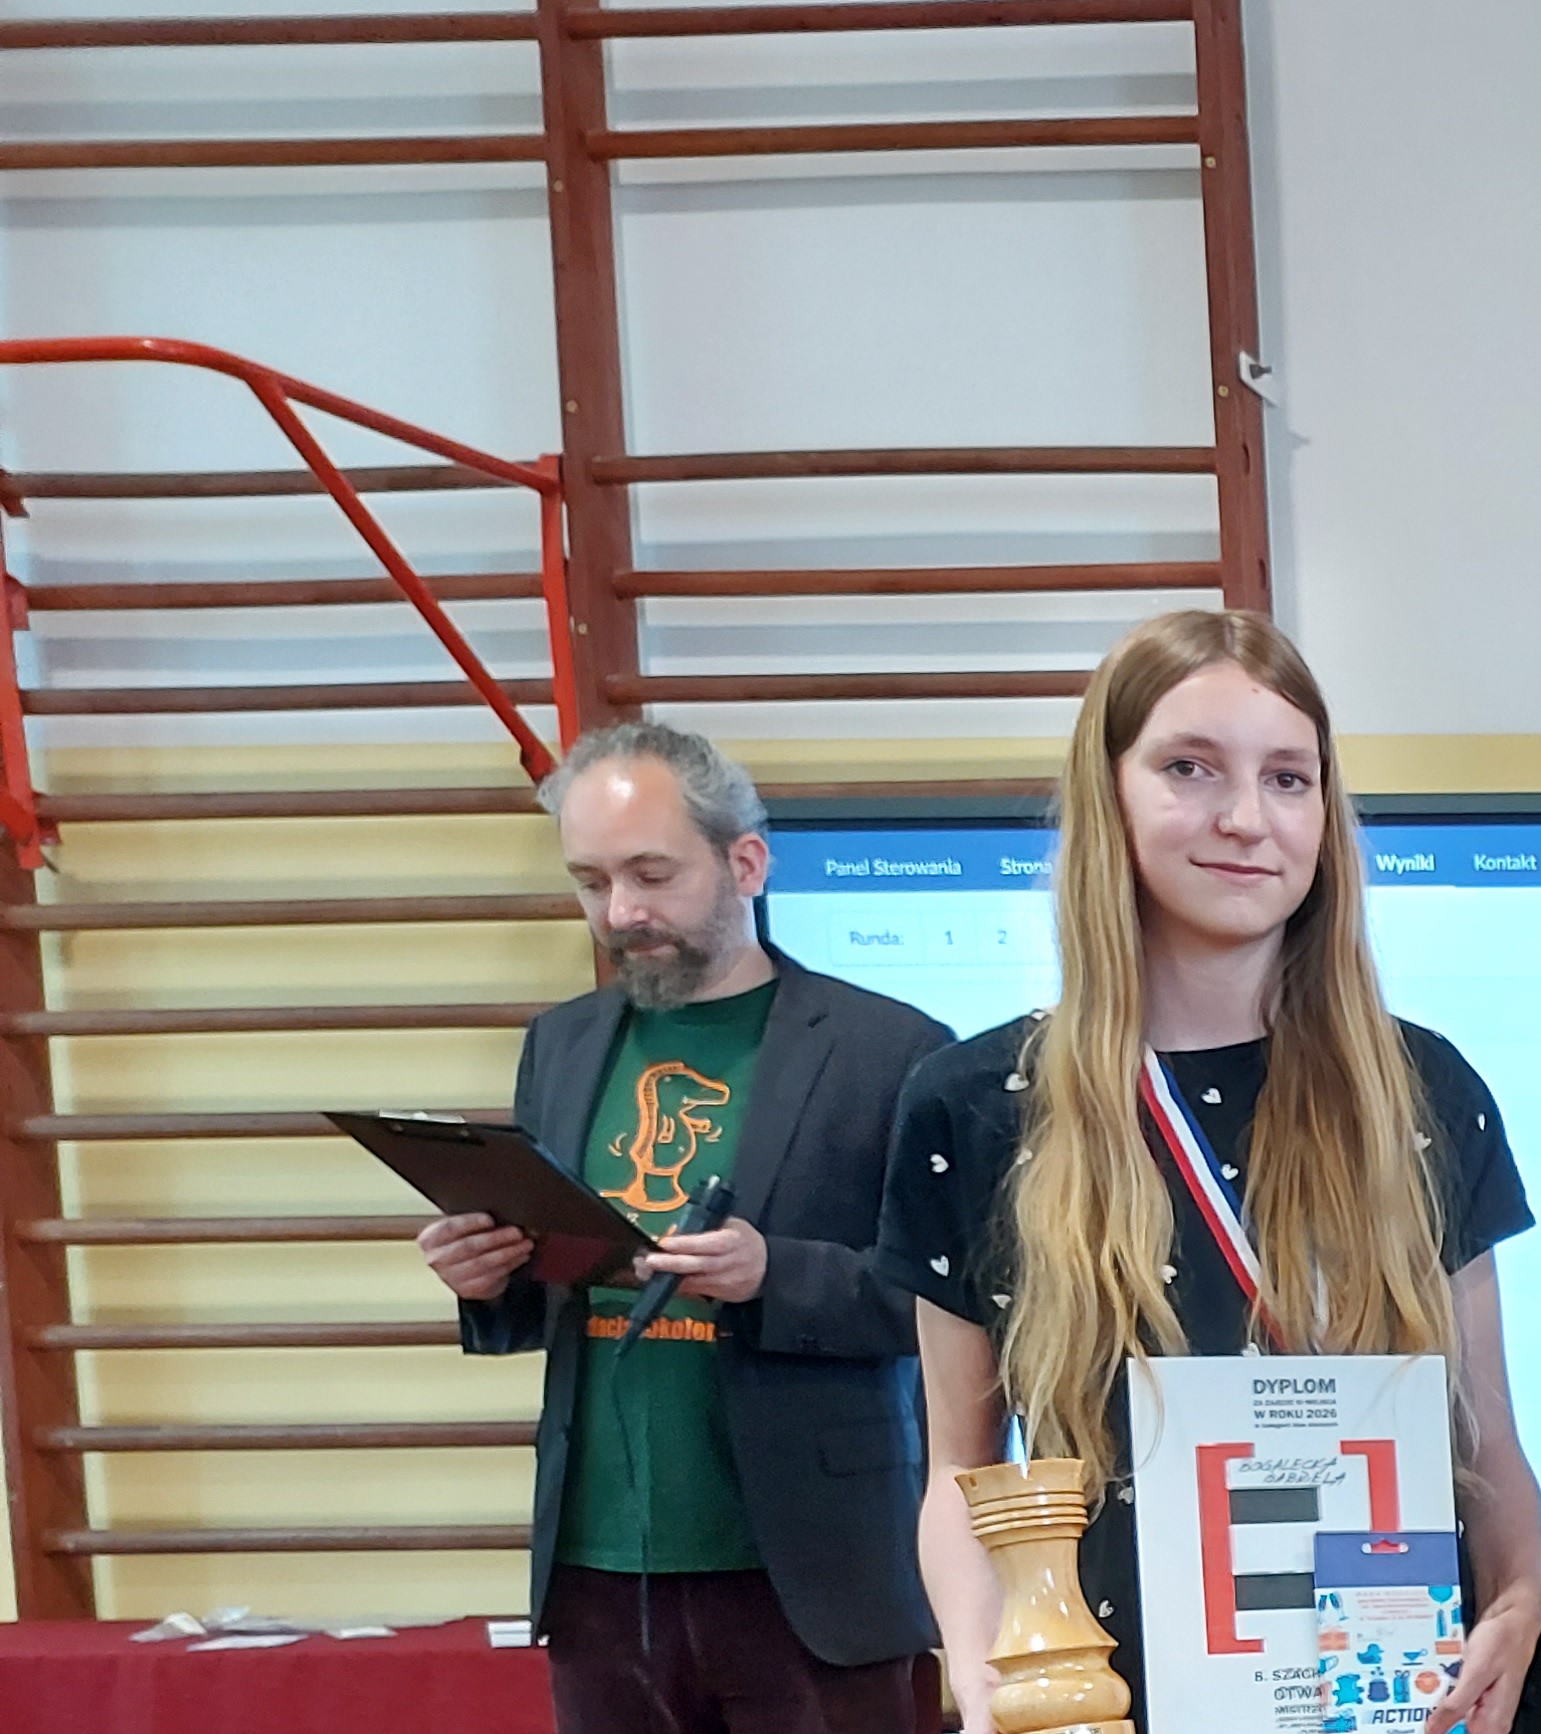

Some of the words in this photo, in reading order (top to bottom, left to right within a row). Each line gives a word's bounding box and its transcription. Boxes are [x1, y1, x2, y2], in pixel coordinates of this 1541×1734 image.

[824, 858, 870, 876] Panel
[873, 857, 962, 876] Sterowania
[1376, 853, 1435, 875] Wyniki
[1473, 853, 1538, 872] Kontakt
[944, 930, 953, 945] 1
[997, 930, 1007, 945] 2
[1253, 1378, 1337, 1394] DYPLOM
[1254, 1410, 1266, 1419] W
[1269, 1409, 1303, 1419] ROKU
